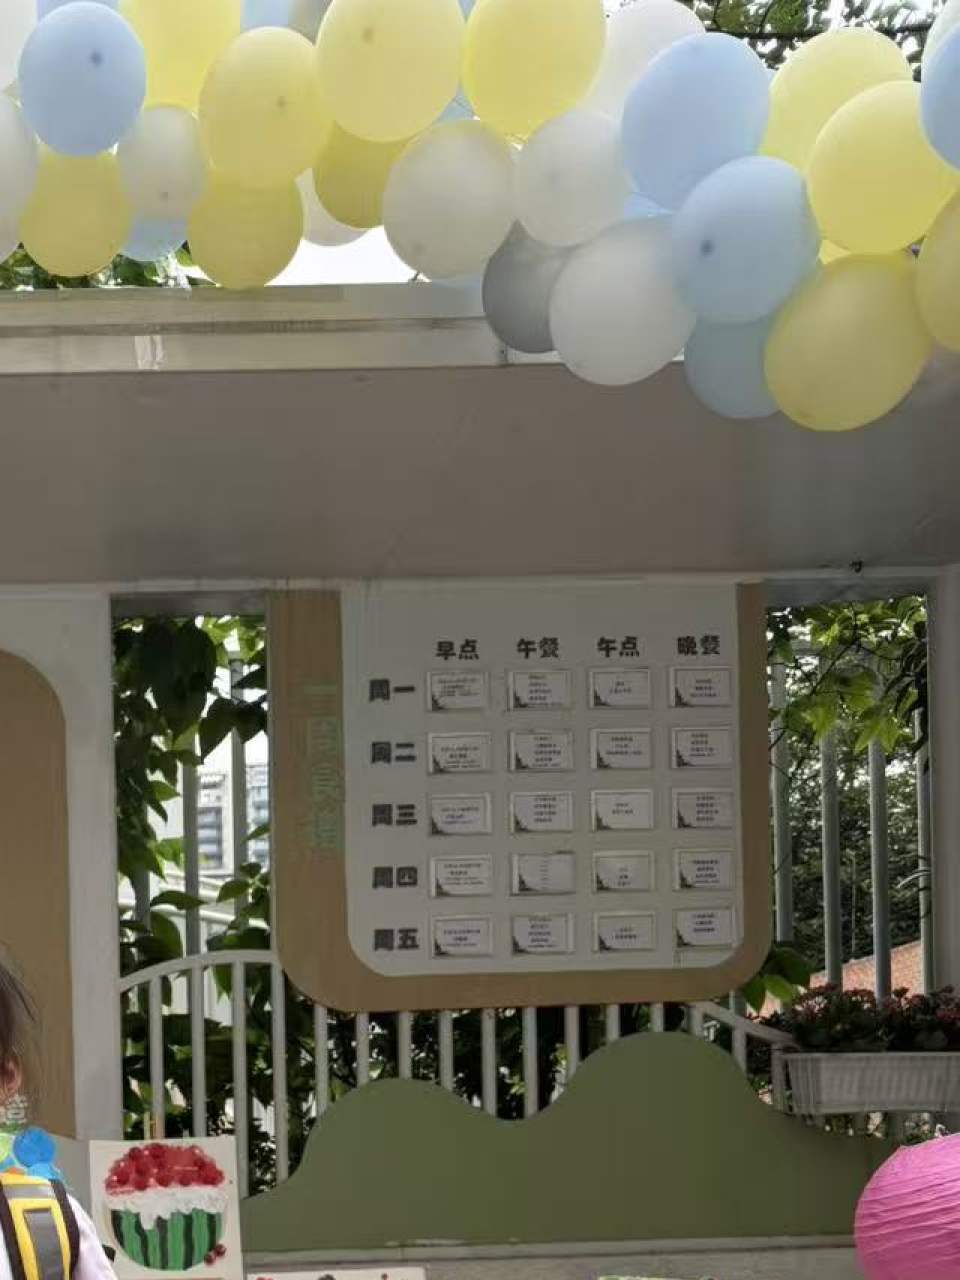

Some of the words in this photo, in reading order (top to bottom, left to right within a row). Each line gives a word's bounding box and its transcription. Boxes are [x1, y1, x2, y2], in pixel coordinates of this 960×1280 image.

[435, 638, 479, 661] 早点
[516, 637, 560, 659] 午餐
[596, 636, 641, 658] 午点
[676, 635, 721, 656] 晚餐
[369, 678, 416, 702] 周一
[371, 741, 416, 764] 周二
[372, 804, 418, 827] 周三
[372, 865, 418, 889] 周四
[373, 927, 419, 951] 周五
